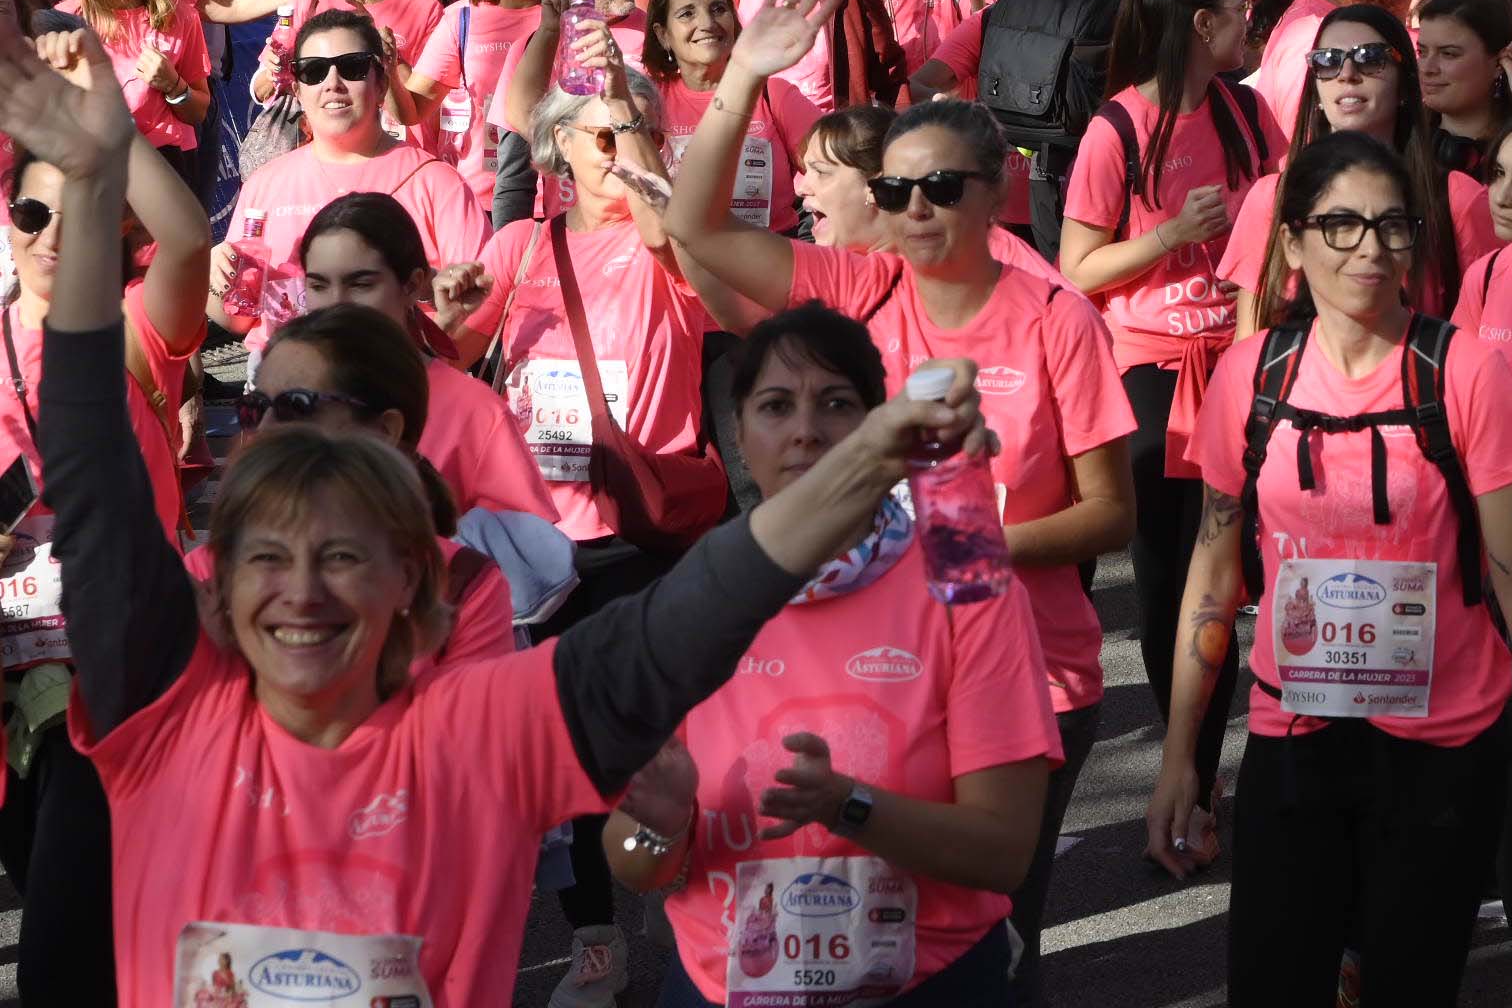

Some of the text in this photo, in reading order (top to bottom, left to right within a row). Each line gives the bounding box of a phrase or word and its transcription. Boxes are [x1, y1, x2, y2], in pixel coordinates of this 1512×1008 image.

[537, 429, 574, 441] 25492
[553, 445, 563, 454] LA
[563, 445, 592, 455] MUJER
[1320, 585, 1382, 601] ASTURIANA
[1392, 582, 1425, 592] SUMA
[1321, 622, 1377, 644] 016
[1325, 650, 1368, 665] 30351
[851, 659, 917, 676] ASTURIANA
[1289, 670, 1416, 683] CARRERA DE LA MUJER 2023
[1367, 692, 1418, 706] Santander
[787, 889, 853, 907] ASTURIANA
[784, 933, 850, 961] 016
[260, 967, 353, 990] ASTURIANA
[794, 969, 836, 986] 5520
[743, 994, 826, 1008] CARRERA DE LA
